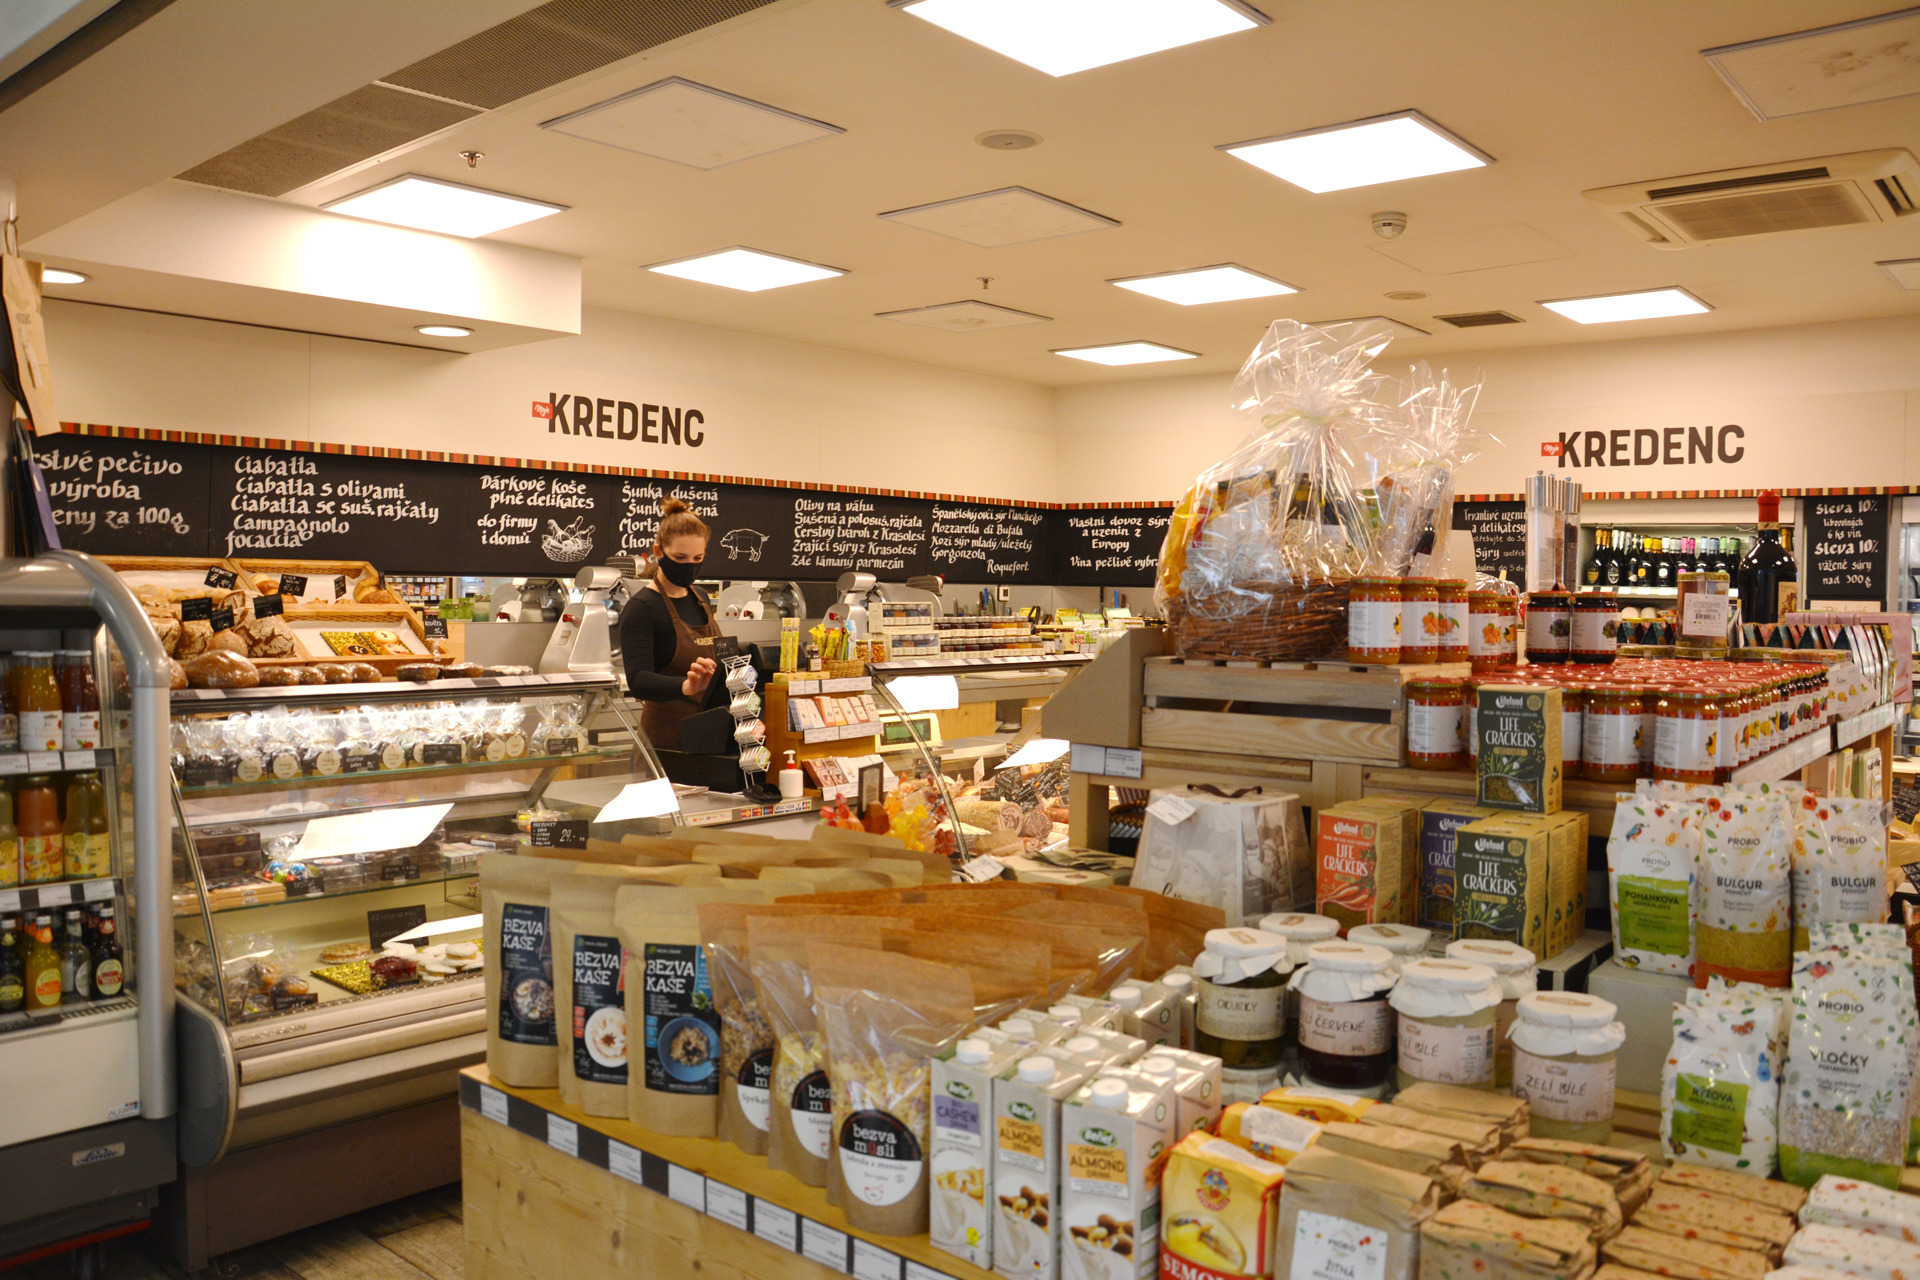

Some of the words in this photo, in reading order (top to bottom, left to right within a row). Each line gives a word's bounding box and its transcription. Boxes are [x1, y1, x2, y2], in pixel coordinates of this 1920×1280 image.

[548, 392, 704, 448] KREDENC
[1557, 424, 1745, 468] KREDENC
[33, 449, 94, 473] rstvé
[97, 450, 183, 484] pečivo
[234, 455, 319, 476] Ciabatta
[50, 477, 142, 503] výroba
[235, 477, 315, 498] Ciabatta
[322, 482, 333, 497] s
[337, 480, 407, 501] olivami
[480, 474, 547, 493] Dárkové
[551, 477, 587, 495] koše
[622, 480, 664, 503] Šunka
[670, 484, 719, 502] dušená
[230, 494, 311, 515] Ciabatta
[315, 498, 336, 515] se
[490, 491, 525, 509] plné
[526, 492, 595, 510] delikates
[794, 498, 825, 514] Olivy
[827, 501, 842, 512] na
[845, 499, 875, 513] váhu
[1816, 503, 1854, 515] Sleva
[52, 508, 96, 535] eny
[104, 510, 131, 530] za
[136, 506, 190, 535] 100g
[477, 515, 498, 528] do
[499, 513, 538, 530] firmy
[794, 511, 838, 528] Sušená
[838, 514, 847, 525] a
[1068, 515, 1105, 529] Vlastní
[1110, 515, 1143, 527] dovoz
[1463, 508, 1499, 521] Trvanlivé
[233, 513, 350, 541] Campagnolo
[618, 517, 660, 534] Morta
[794, 524, 835, 541] Čerstvý
[837, 525, 871, 540] tvaroh
[872, 530, 880, 540] z
[931, 522, 980, 537] Mozzarella
[983, 524, 994, 535] di
[996, 524, 1024, 539] Bufala
[1081, 528, 1089, 537] a
[1091, 526, 1130, 538] uzenin
[1134, 528, 1142, 538] z
[1471, 524, 1477, 533] a
[1827, 529, 1833, 539] 6
[1834, 529, 1845, 540] ks
[225, 530, 302, 557] focaccia
[489, 531, 532, 546] domů
[833, 540, 858, 555] sýry
[859, 544, 867, 554] z
[954, 536, 970, 549] sýr
[1091, 538, 1130, 553] Evropy
[1506, 535, 1516, 543] do
[931, 547, 986, 564] Gorgonzola
[1475, 547, 1500, 562] Sýry
[1814, 541, 1855, 556] Sleva
[791, 554, 812, 568] Zde
[815, 554, 854, 570] lámaný
[856, 555, 905, 571] parmezán
[986, 558, 1030, 577] Roquefort
[1095, 555, 1133, 572] pečlivě
[1822, 575, 1841, 585] nad
[1500, 716, 1521, 732] LIFE
[1485, 729, 1537, 748] CRACKERS
[1728, 836, 1761, 847] PROBIO
[1830, 835, 1867, 845] PROBIO
[1336, 842, 1355, 860] LIFE
[1428, 851, 1456, 869] CRAC
[1323, 854, 1369, 877] CRACKERS
[1478, 860, 1501, 878] LIFE
[1641, 857, 1671, 868] PROBIO
[1463, 873, 1518, 896] CRACKERS
[1716, 876, 1763, 890] BULGUR
[1831, 876, 1876, 888] BULGUR
[1625, 890, 1680, 906] POHANKOVÁ
[503, 918, 544, 936] BEZVA
[502, 932, 536, 951] KAŠE
[574, 951, 620, 970] BEZVA
[646, 958, 695, 977] BEZVA
[574, 967, 612, 986] KAŠE
[646, 975, 687, 995] KAŠE
[1818, 1000, 1865, 1013] PROBIO
[1315, 1012, 1366, 1034] ČERVENÉ
[1809, 1049, 1870, 1068] VLOČKY
[936, 1105, 978, 1123] CASHEW
[852, 1122, 898, 1145] bezva
[999, 1127, 1042, 1147] ALMOND
[1070, 1154, 1126, 1173] ALMOND
